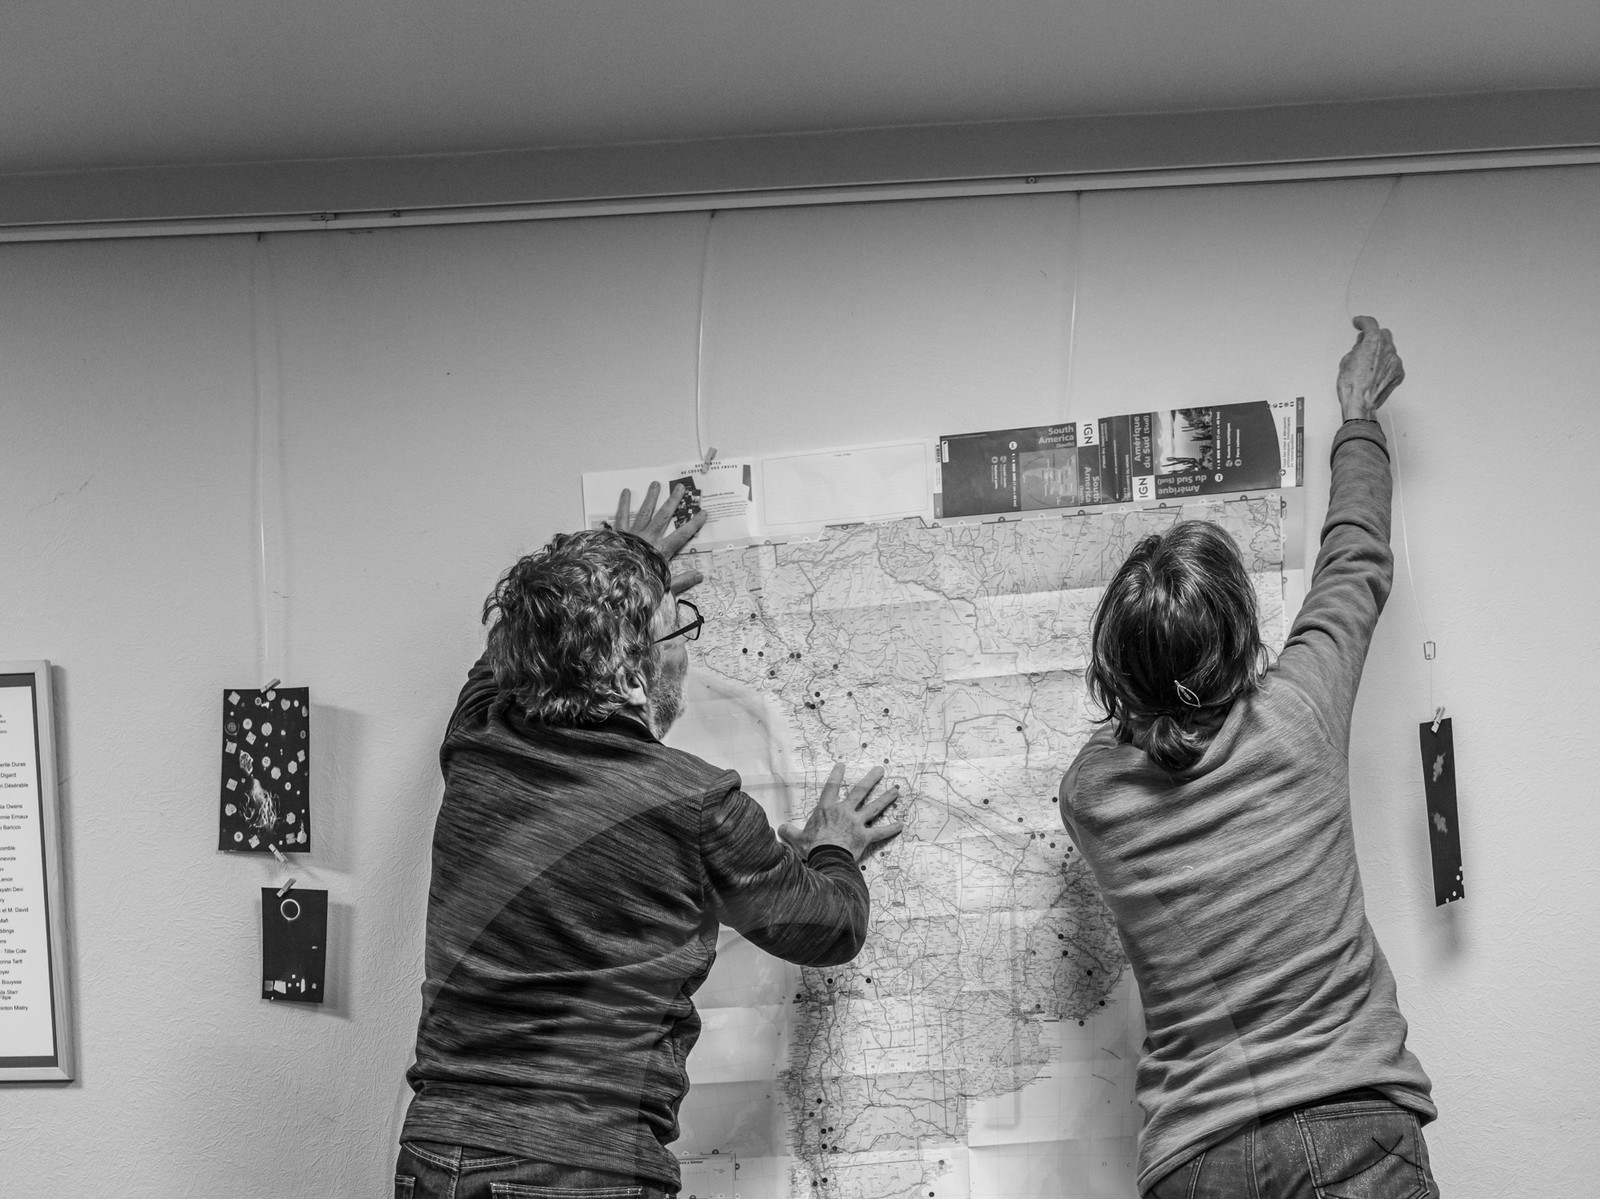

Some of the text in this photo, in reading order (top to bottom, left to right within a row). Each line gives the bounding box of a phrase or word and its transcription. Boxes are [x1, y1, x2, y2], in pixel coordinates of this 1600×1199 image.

[1038, 434, 1074, 444] America
[1048, 425, 1074, 435] South
[1084, 424, 1093, 444] IGN
[1133, 416, 1142, 462] Amérique
[1142, 436, 1150, 454] Sud
[1143, 456, 1150, 468] du
[1084, 466, 1092, 503] America
[1139, 478, 1148, 498] IGN
[1176, 475, 1193, 484] Sud
[1092, 476, 1100, 502] South
[1158, 485, 1200, 494] Amérique
